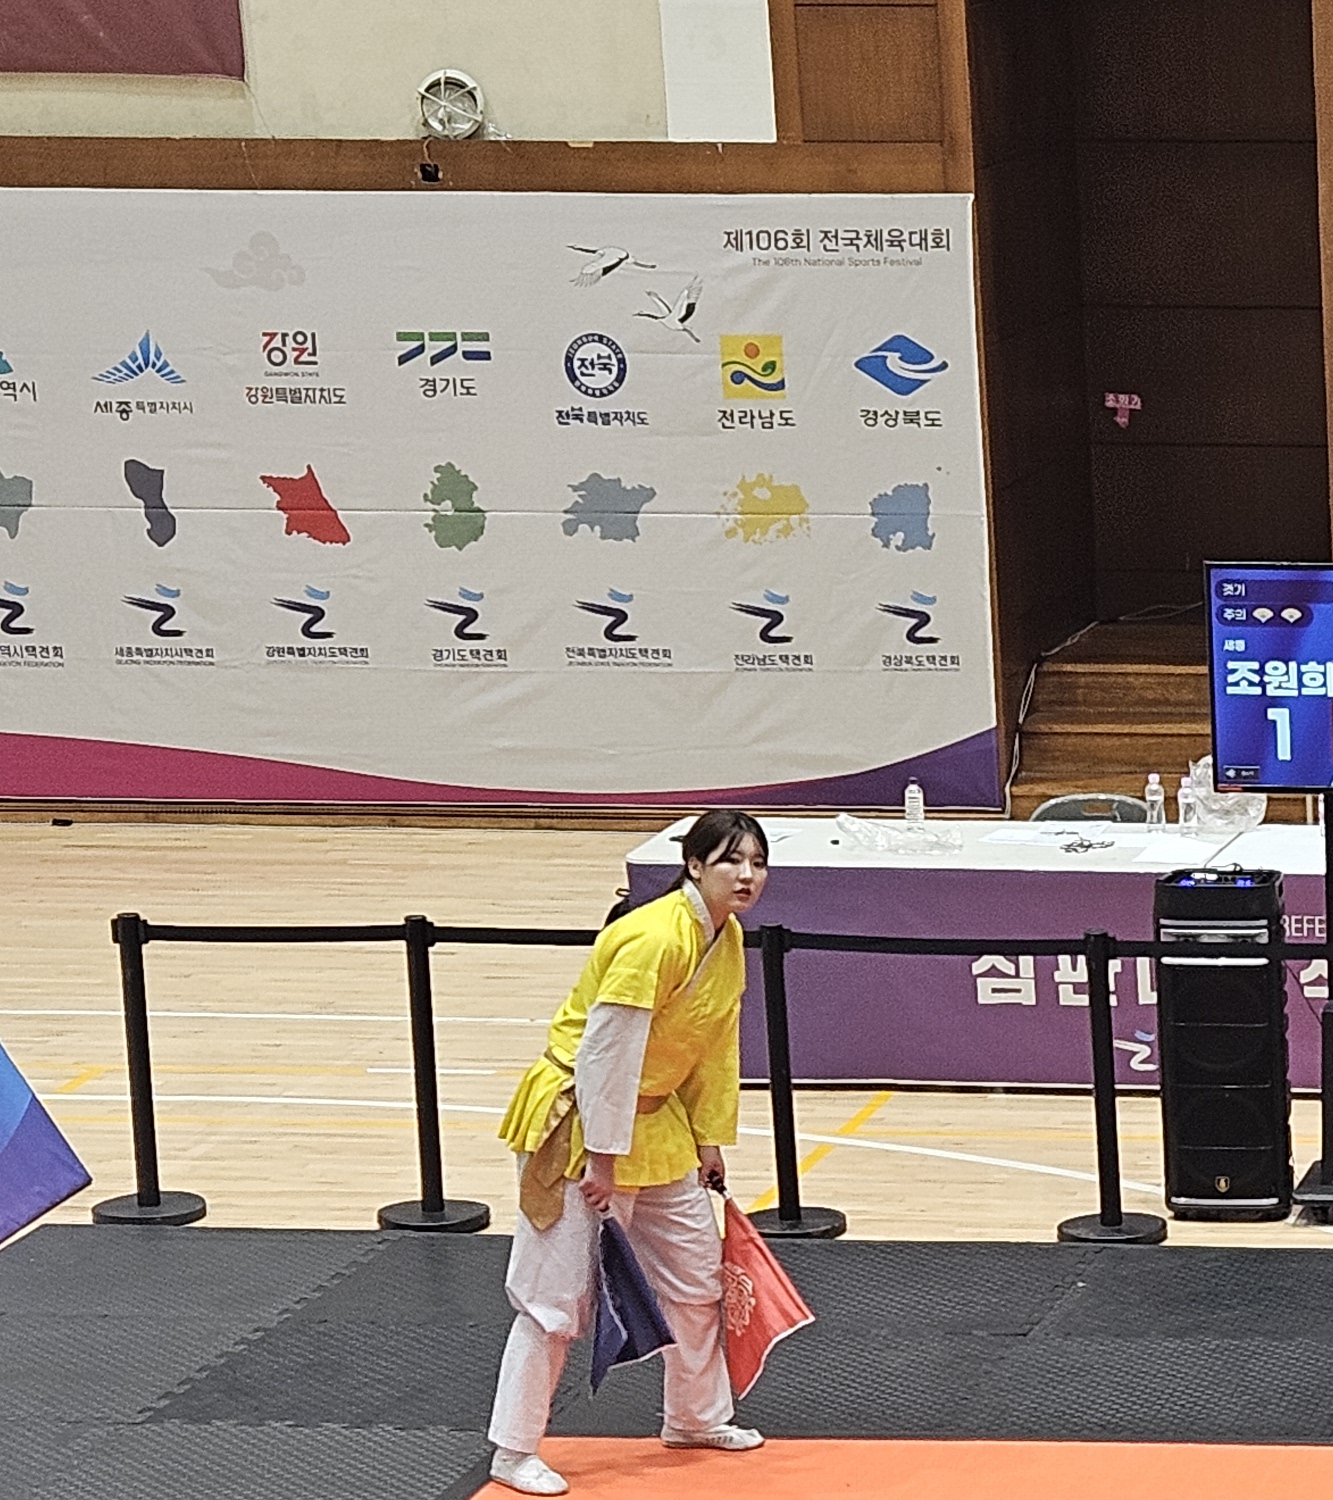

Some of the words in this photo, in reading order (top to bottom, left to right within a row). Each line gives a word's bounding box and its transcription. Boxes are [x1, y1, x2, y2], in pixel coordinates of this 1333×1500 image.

[722, 228, 811, 253] 제106회
[818, 228, 951, 253] 전국체육대회
[803, 257, 845, 266] National
[848, 257, 881, 268] Sports
[883, 257, 923, 266] Festival
[261, 330, 319, 367] 강원
[576, 353, 616, 377] 전북
[245, 386, 347, 405] 강원특별자치도
[419, 377, 478, 398] 경기도
[717, 409, 797, 430] 전라남도
[859, 408, 944, 429] 경상북도
[1266, 707, 1292, 761] 1
